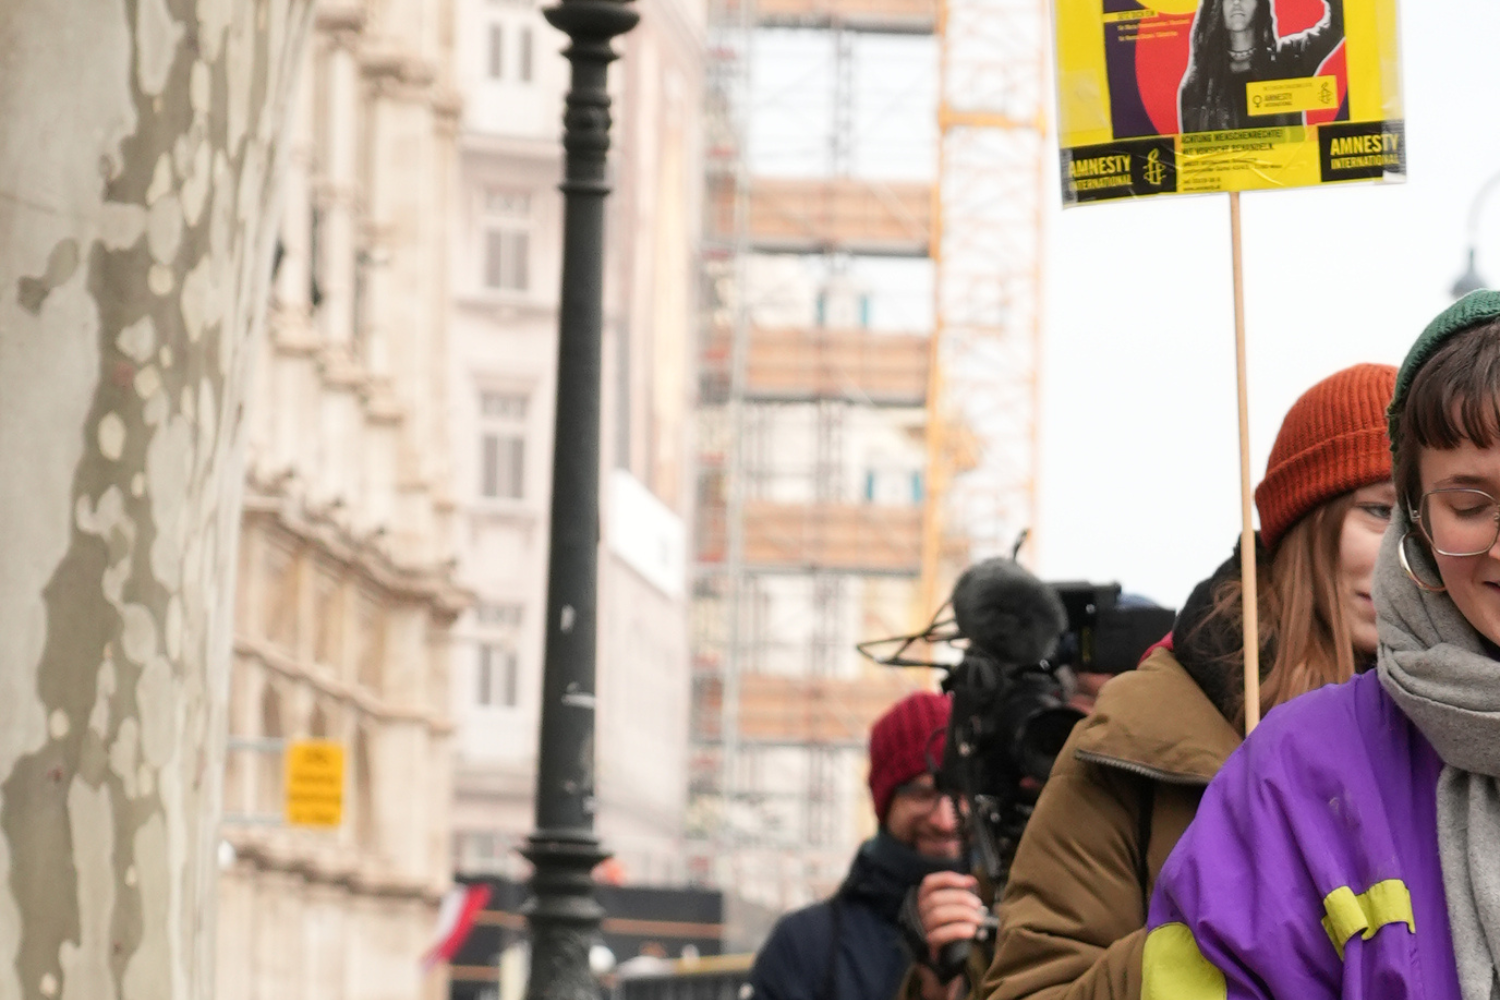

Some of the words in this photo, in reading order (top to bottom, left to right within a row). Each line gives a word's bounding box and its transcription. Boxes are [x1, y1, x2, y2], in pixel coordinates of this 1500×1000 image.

[1330, 133, 1399, 156] AMNESTY
[1068, 154, 1131, 178] AMNESTY
[1331, 153, 1400, 170] INTERNATIONAL
